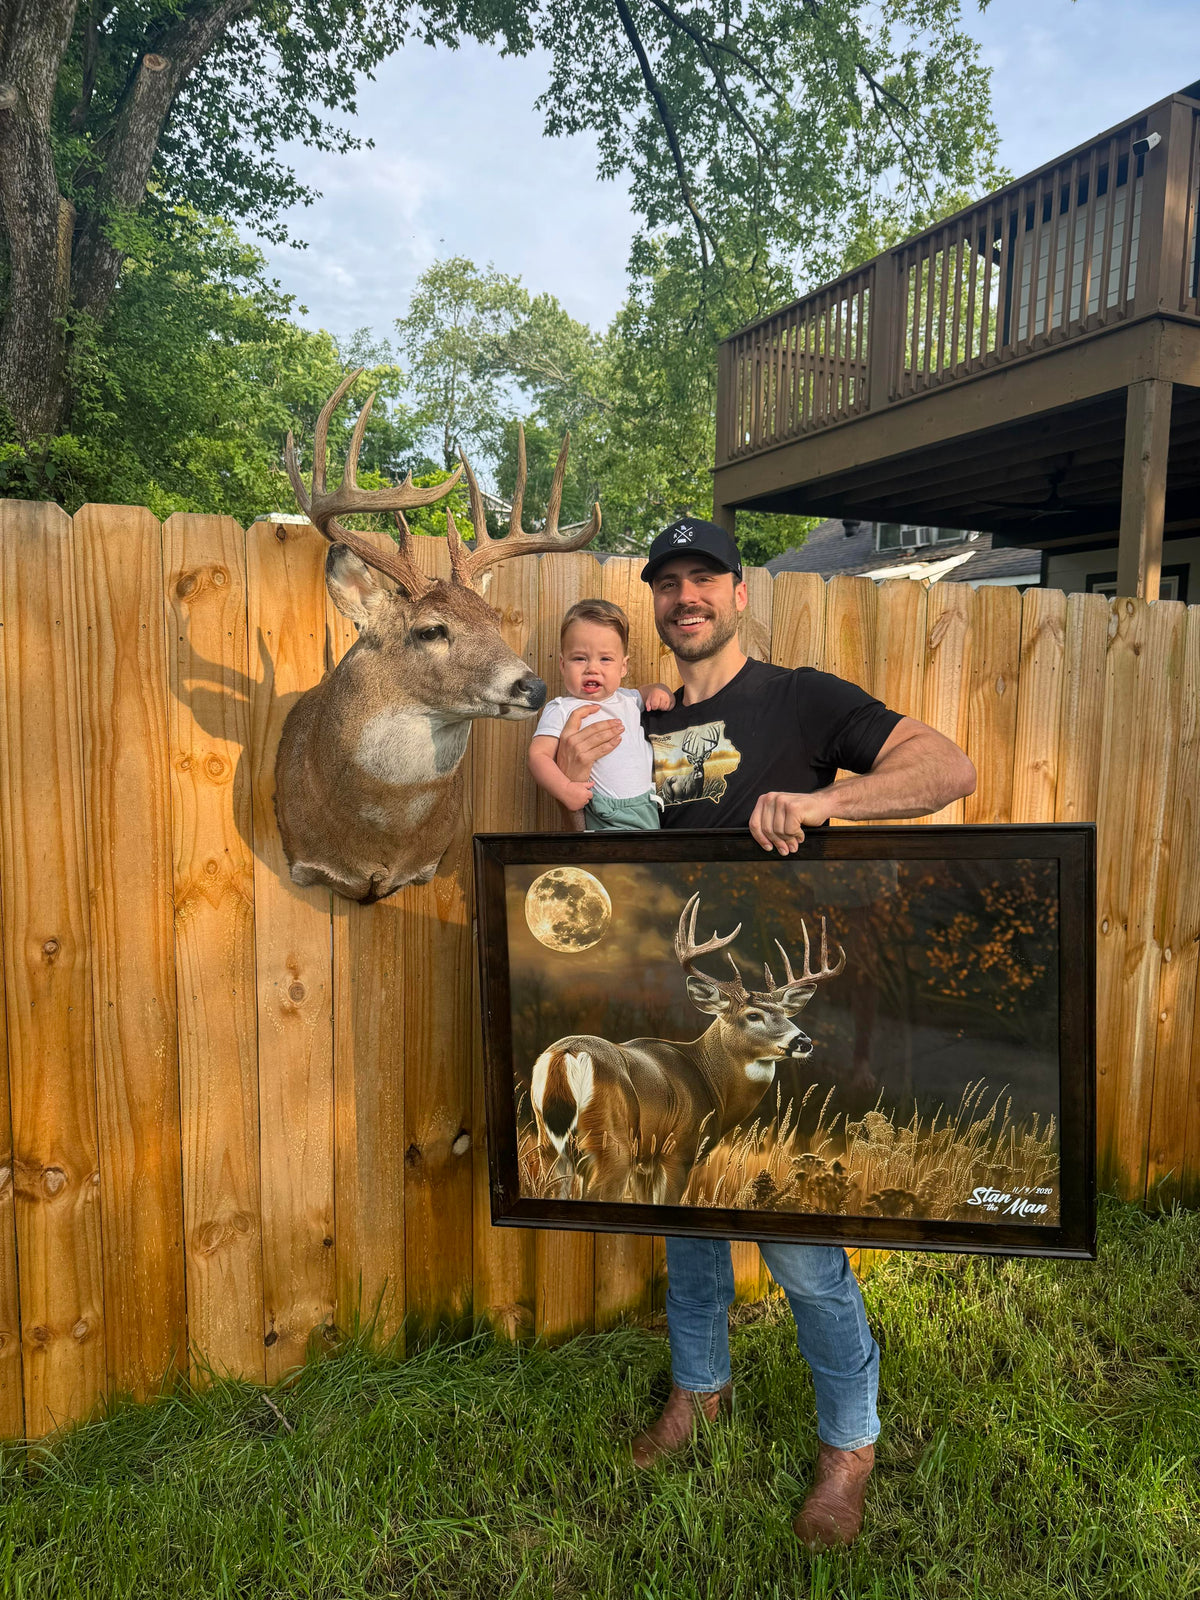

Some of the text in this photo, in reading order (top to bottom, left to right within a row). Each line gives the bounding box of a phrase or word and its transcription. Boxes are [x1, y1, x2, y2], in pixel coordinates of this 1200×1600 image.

[1012, 1185, 1053, 1195] 11/9/2020
[967, 1186, 1049, 1218] Stan the Man
